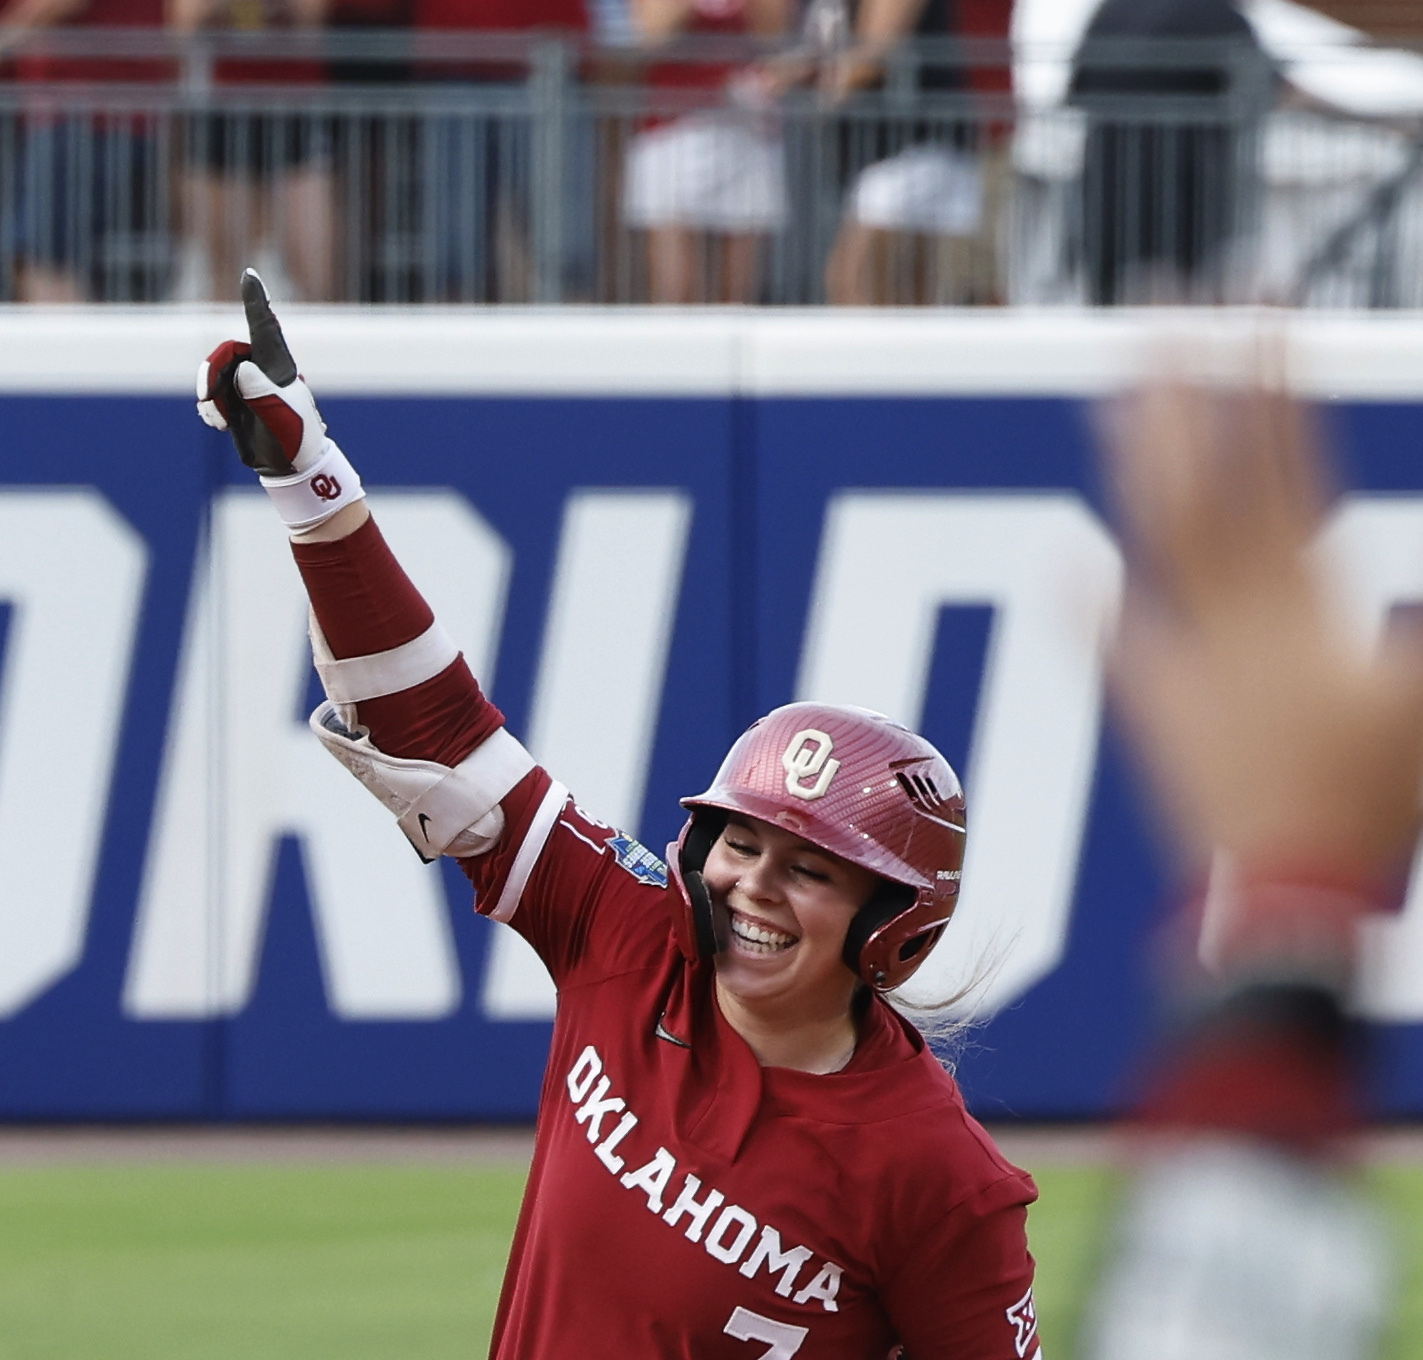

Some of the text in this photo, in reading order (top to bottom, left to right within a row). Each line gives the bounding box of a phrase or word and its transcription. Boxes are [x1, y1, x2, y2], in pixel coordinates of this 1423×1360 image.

[310, 474, 342, 500] OU
[782, 729, 841, 800] OU
[567, 1046, 845, 1312] OKLAHOMA
